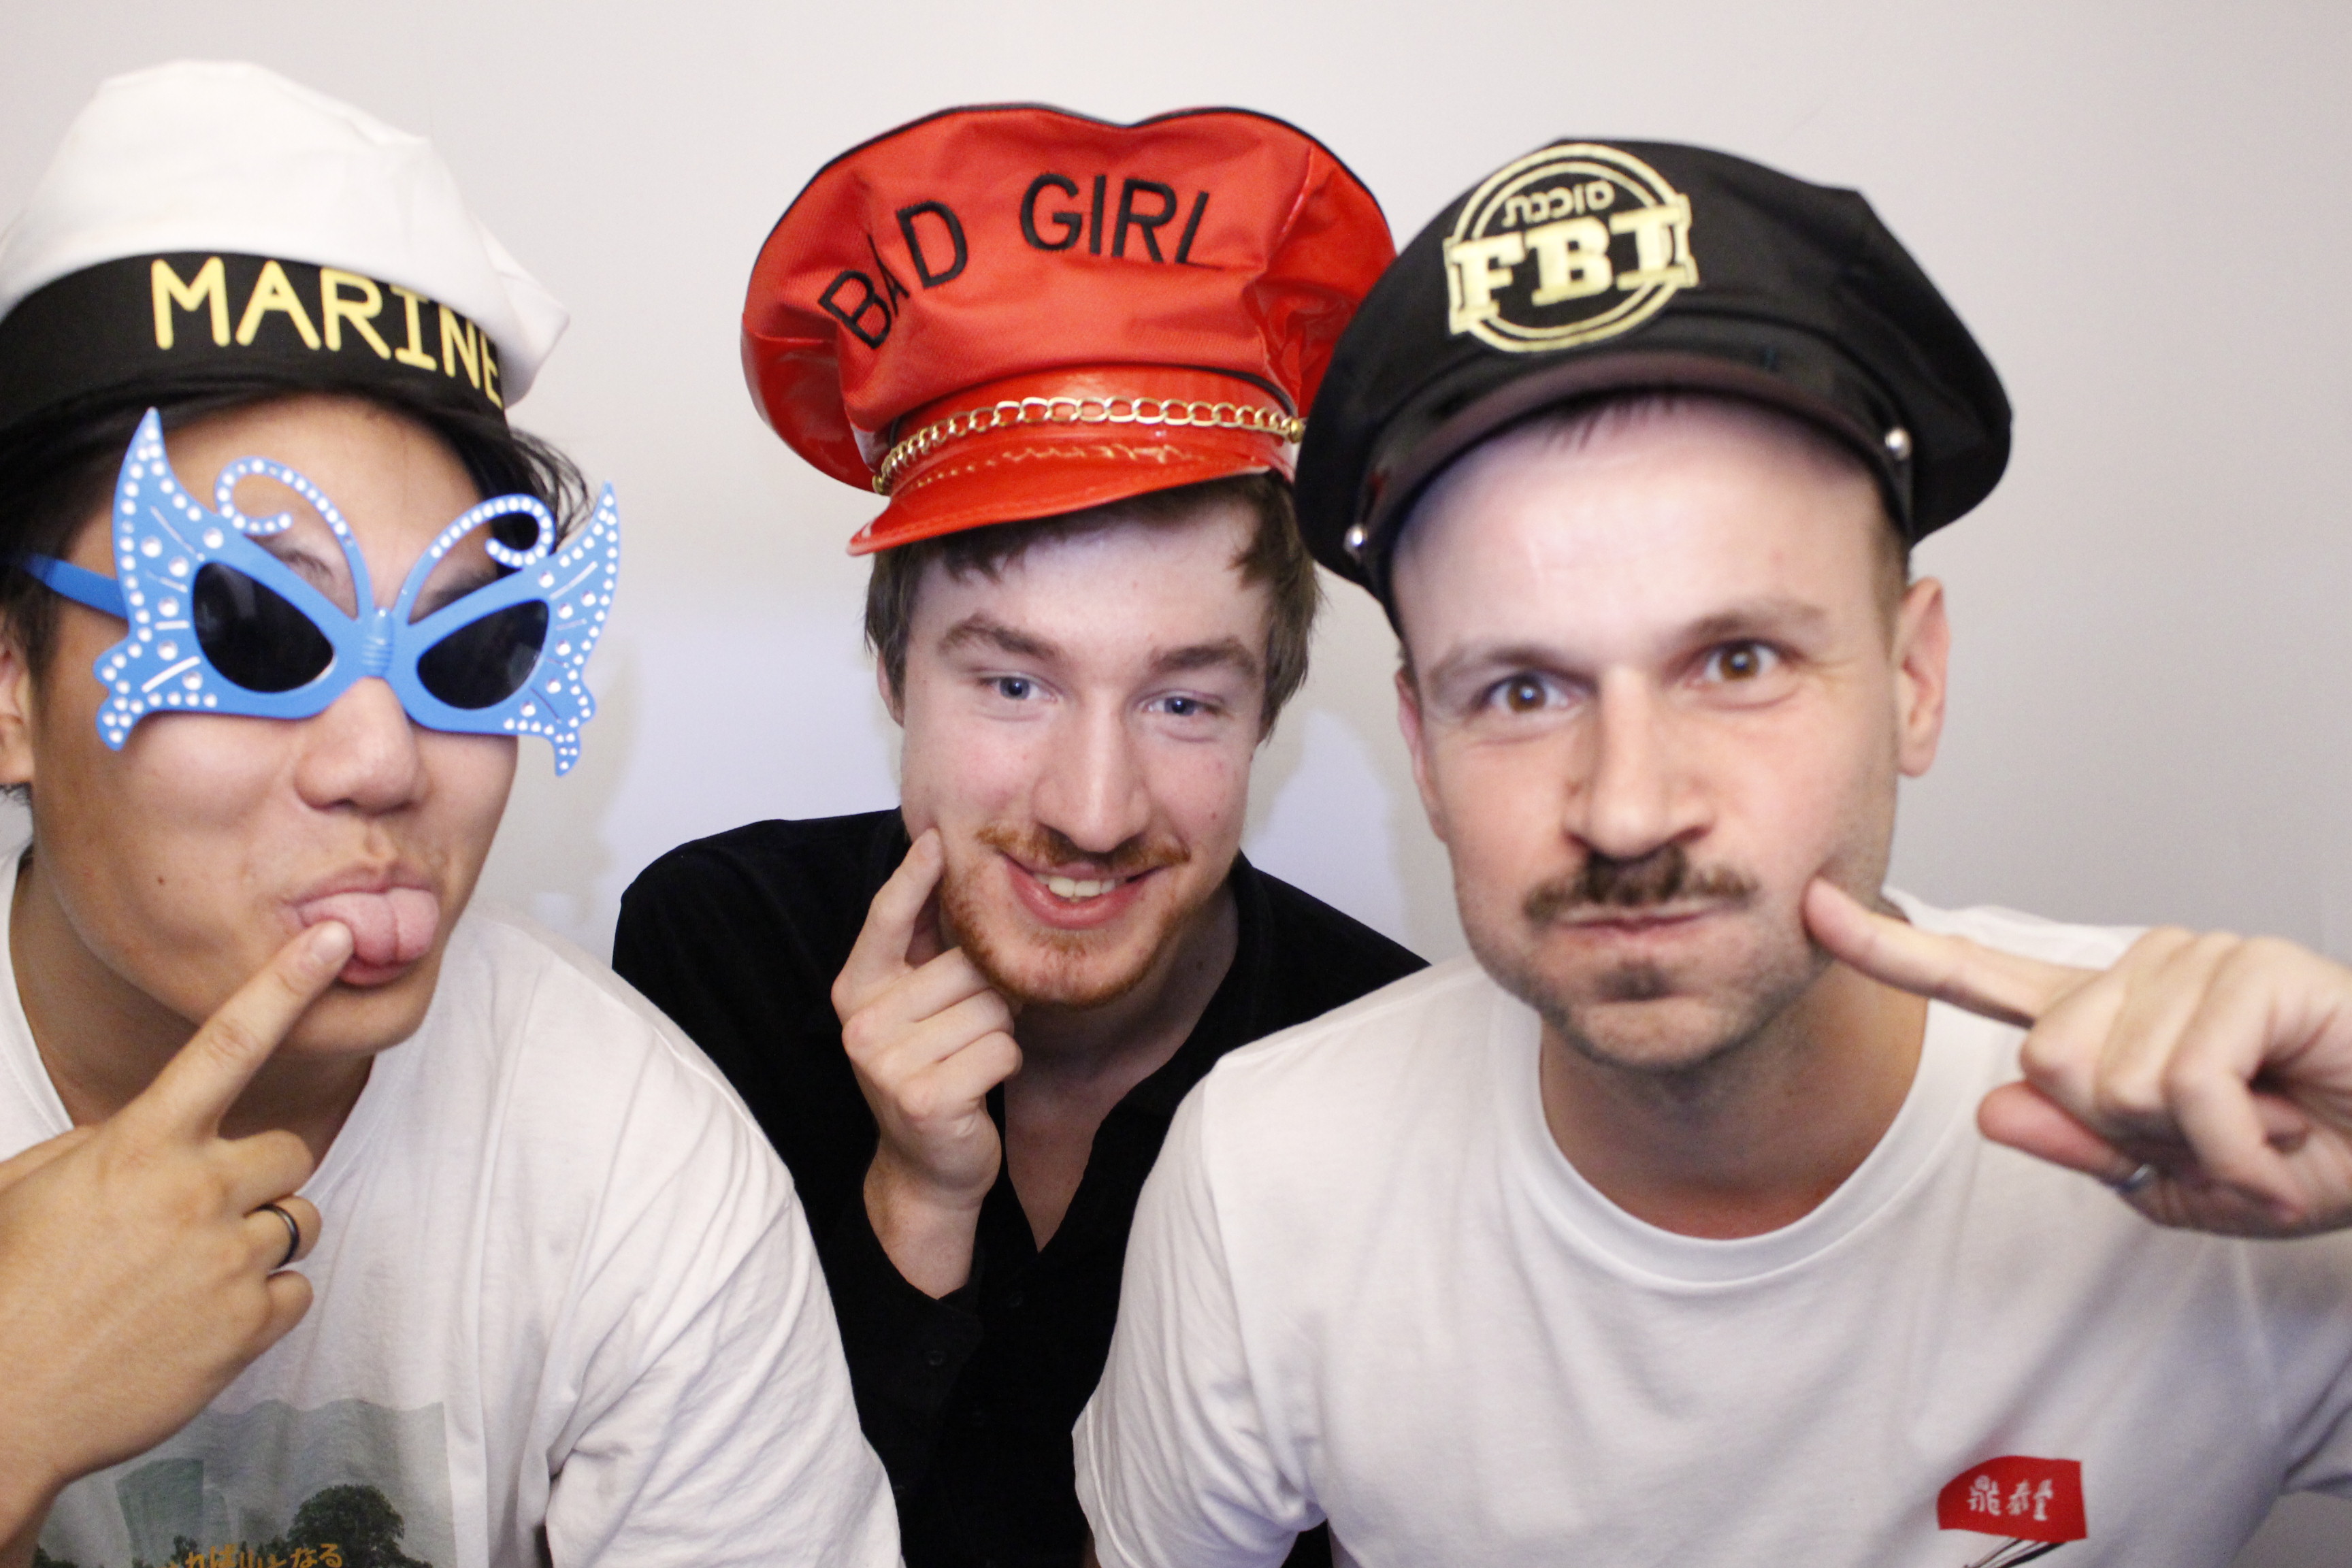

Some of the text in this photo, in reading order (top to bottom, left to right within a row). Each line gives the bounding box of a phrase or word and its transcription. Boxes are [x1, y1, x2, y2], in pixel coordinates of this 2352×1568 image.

[817, 172, 1224, 350] BAD GIRL
[1446, 204, 1691, 323] FBI
